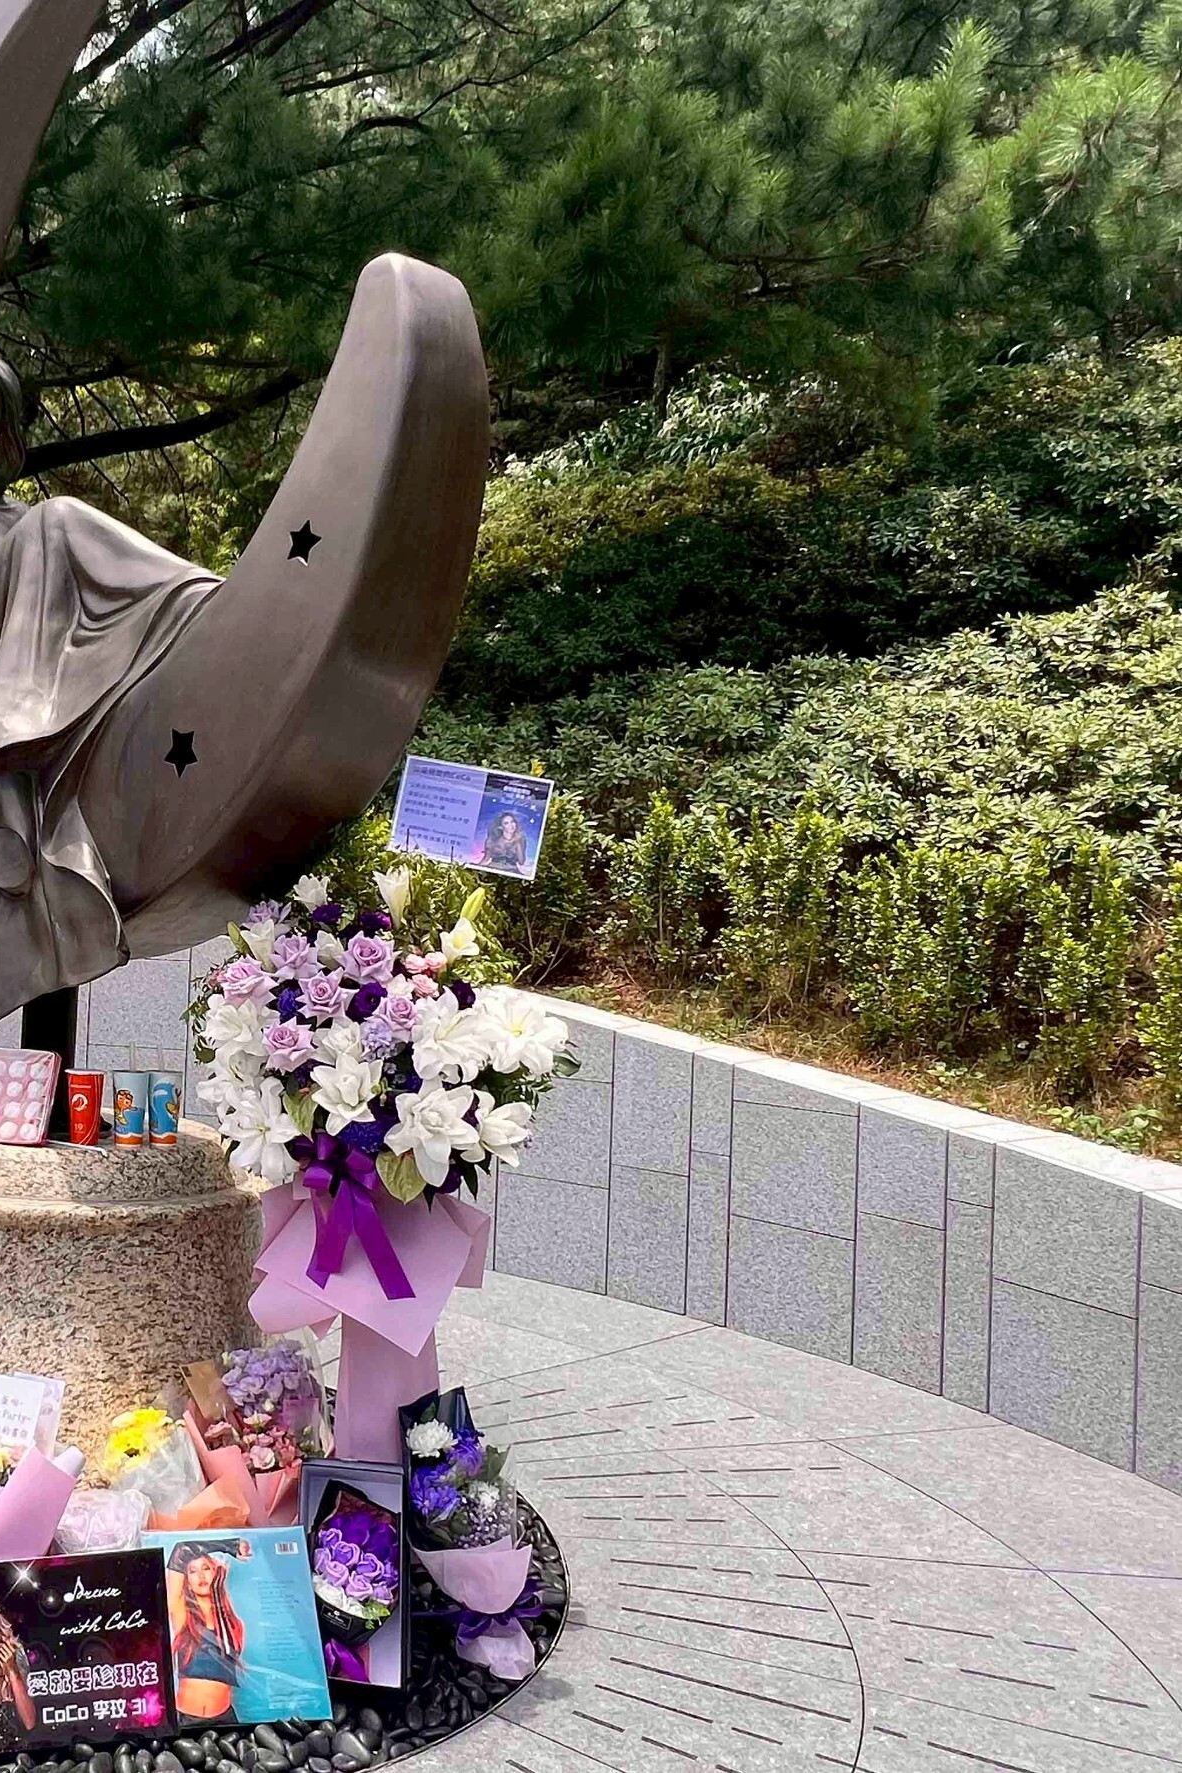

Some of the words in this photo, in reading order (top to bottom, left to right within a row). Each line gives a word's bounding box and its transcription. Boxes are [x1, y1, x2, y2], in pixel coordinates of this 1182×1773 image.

[59, 1615, 102, 1635] with
[104, 1609, 149, 1631] CoCo
[42, 1705, 89, 1724] CoCo
